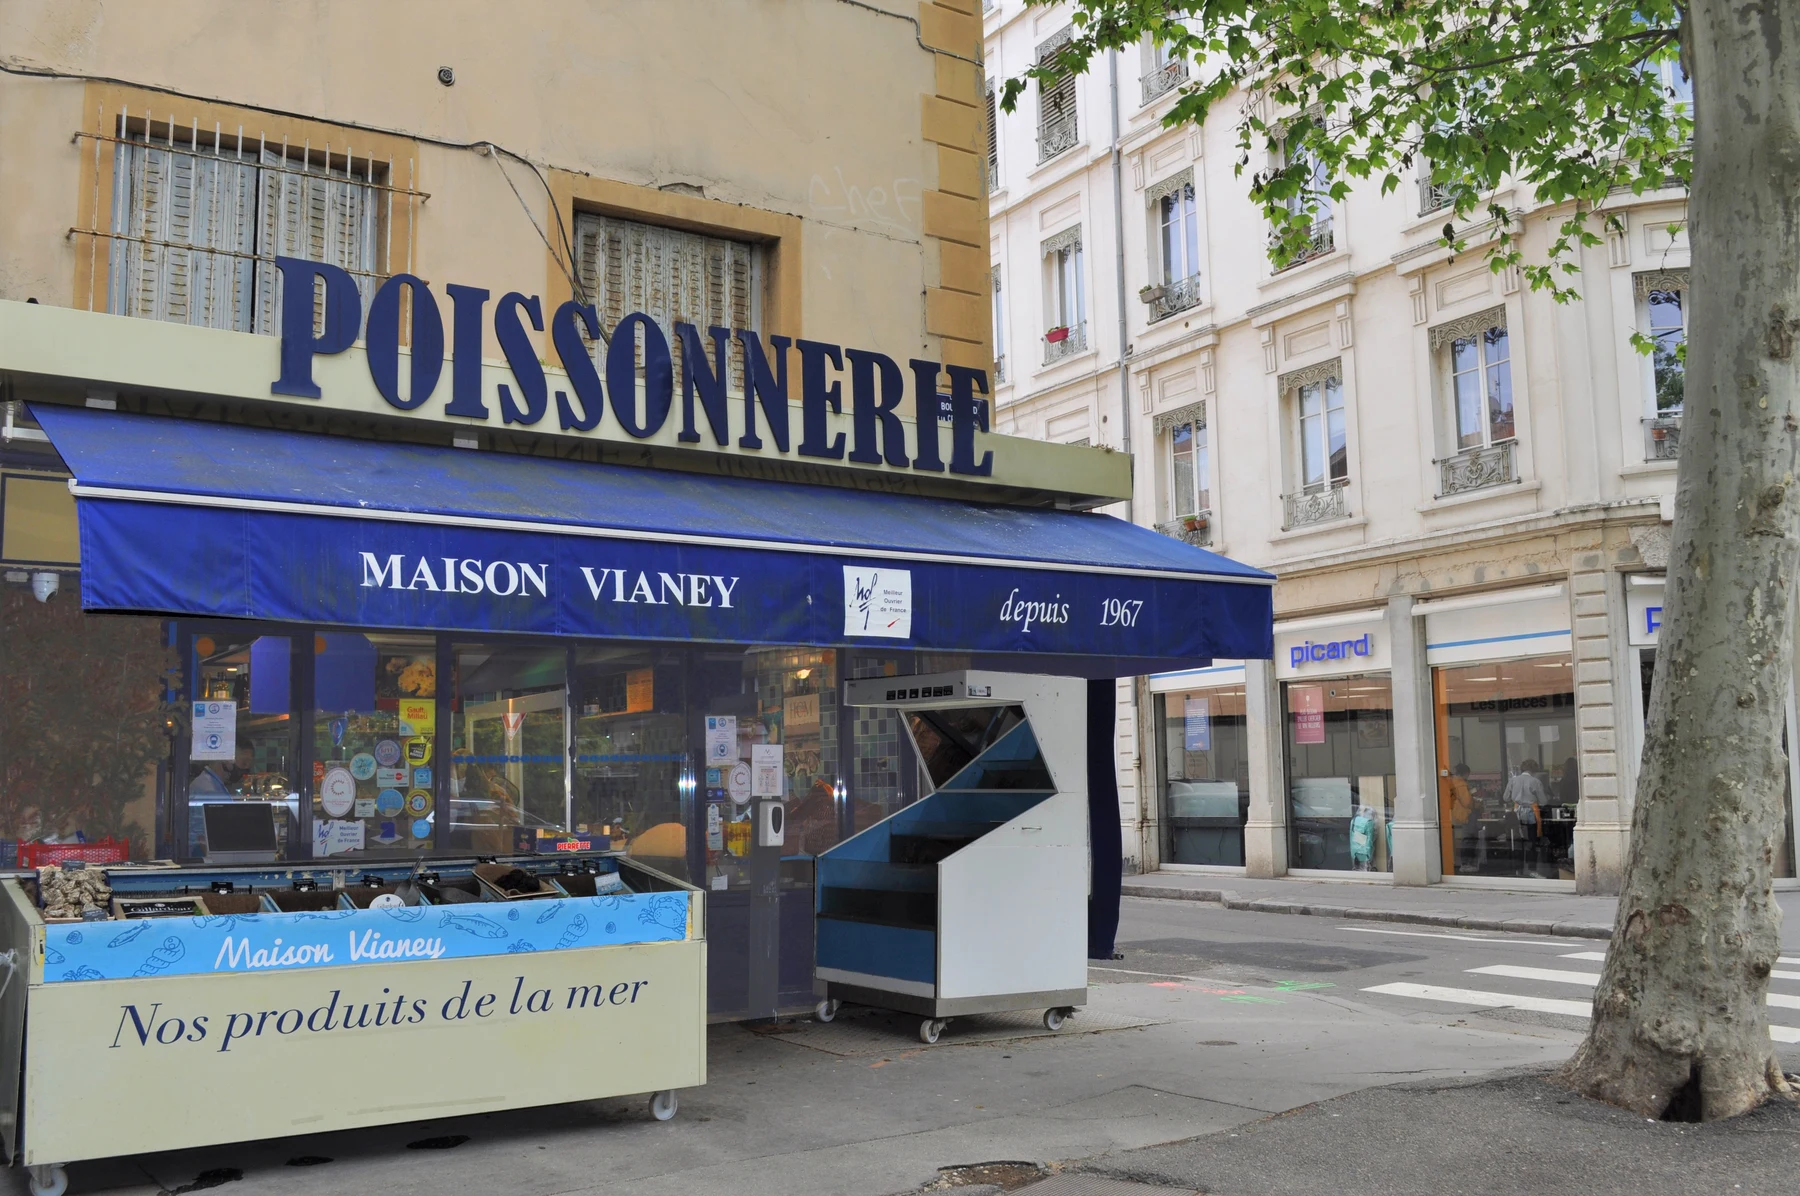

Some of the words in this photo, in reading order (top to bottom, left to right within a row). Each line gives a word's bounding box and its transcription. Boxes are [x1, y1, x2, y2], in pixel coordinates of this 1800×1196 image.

[271, 257, 993, 477] POISSONNERIE
[359, 551, 549, 598] MAISON
[580, 566, 740, 608] VIANEY
[999, 588, 1070, 633] depuis
[1100, 598, 1144, 627] 1967
[1291, 633, 1370, 668] picard
[215, 936, 334, 971] Maison
[349, 929, 446, 961] Vianey
[109, 1003, 209, 1049] Nos
[218, 986, 427, 1053] produits
[441, 980, 497, 1021] de
[509, 976, 553, 1014] la
[566, 978, 649, 1009] mer
